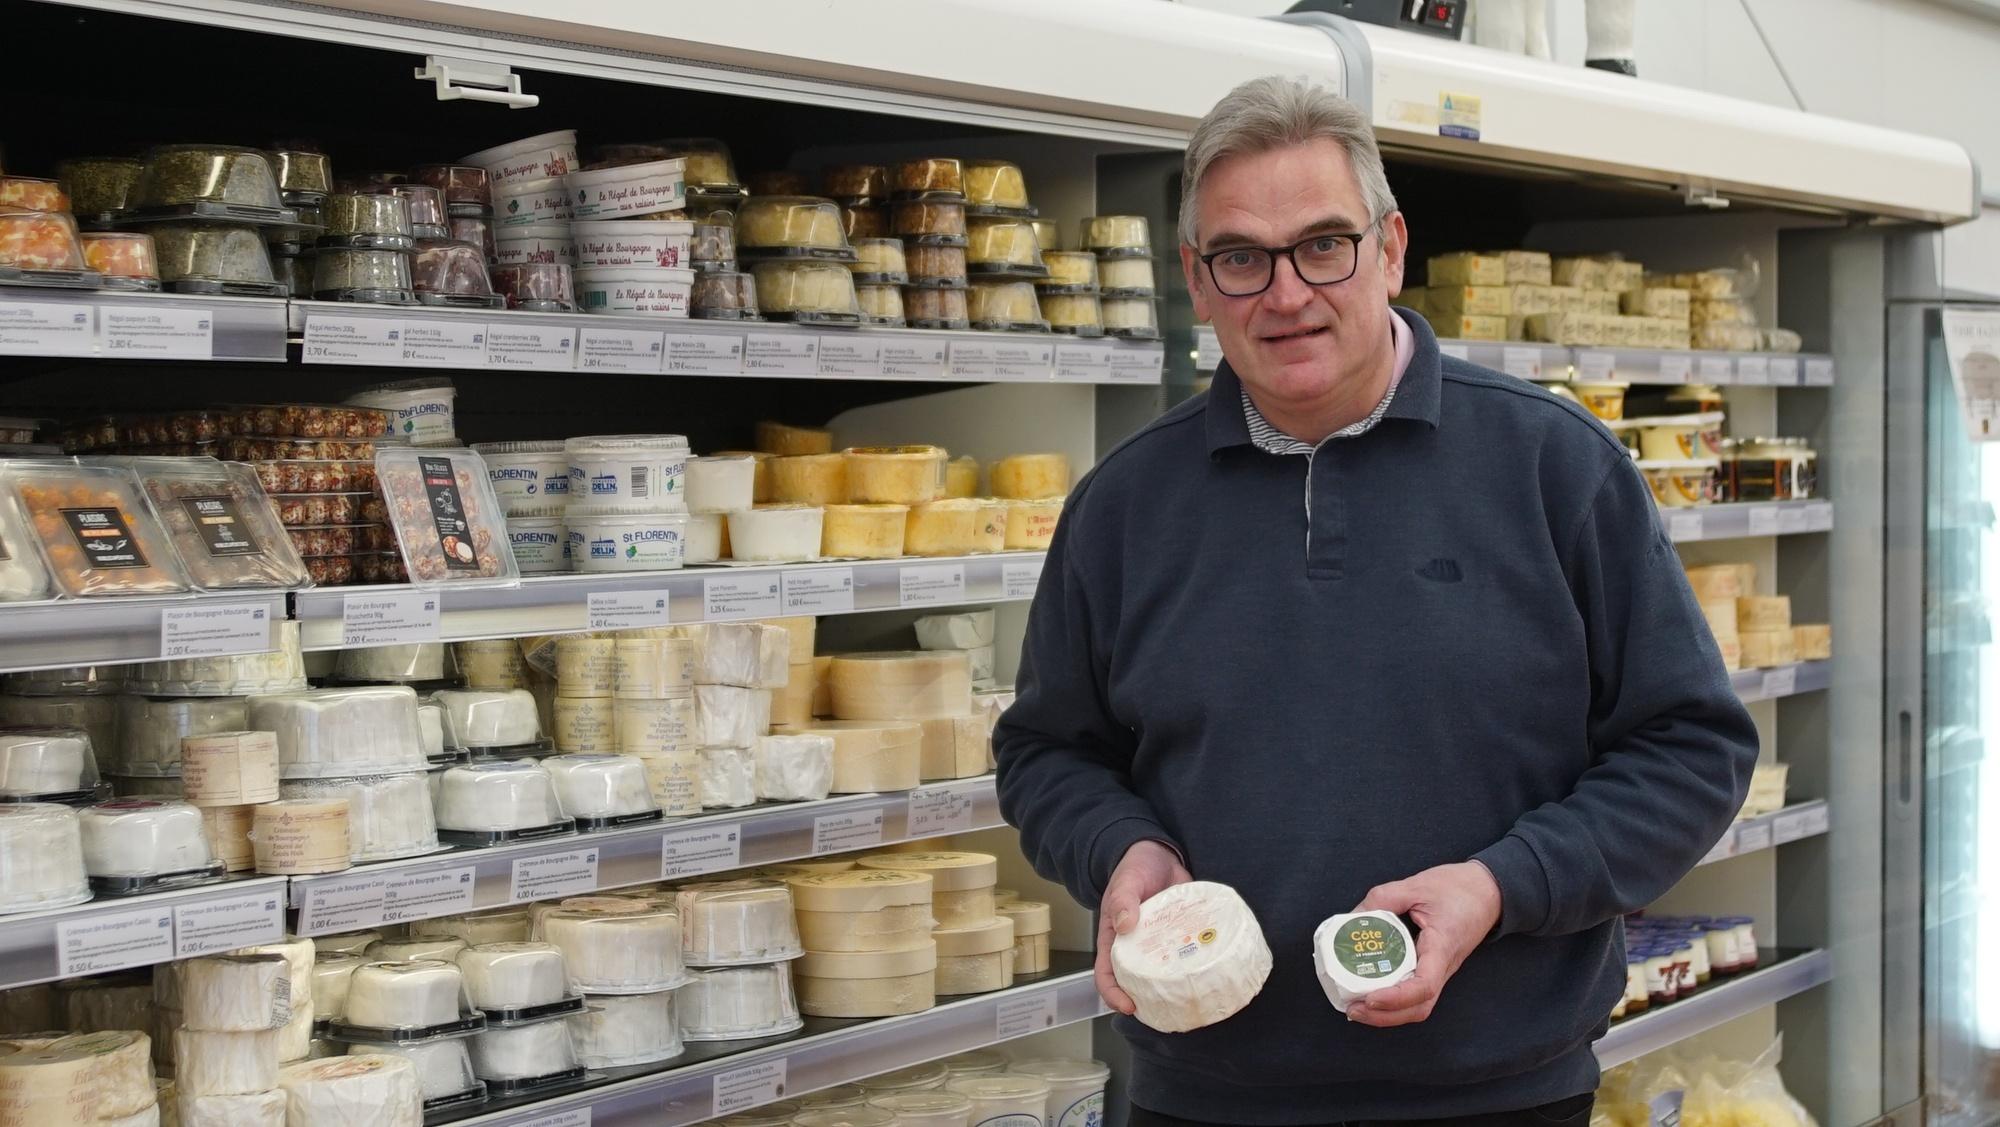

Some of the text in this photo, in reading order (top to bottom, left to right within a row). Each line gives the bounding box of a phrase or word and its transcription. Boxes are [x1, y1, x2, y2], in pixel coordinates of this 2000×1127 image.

[504, 162, 540, 178] Bourgogne
[599, 184, 672, 202] Le Régal de Bourgogne
[534, 197, 564, 212] Le Régal
[619, 198, 656, 212] aux raisins
[588, 243, 605, 255] Régal
[606, 243, 614, 252] de
[615, 242, 652, 255] Bourgogne
[609, 256, 632, 265] raisins
[615, 288, 625, 300] Le
[625, 288, 647, 302] Régal
[648, 288, 657, 299] de
[652, 302, 671, 312] raisins
[307, 347, 322, 357] 3,70
[410, 402, 449, 416] FLORENTIN
[665, 466, 673, 477] St
[592, 482, 617, 491] DELIN
[623, 530, 678, 543] St FLORENTIN
[591, 546, 617, 555] DELIN
[371, 601, 397, 610] Bourgogne
[185, 611, 193, 619] de
[193, 609, 223, 619] Bourgogne
[224, 608, 250, 617] Moutarde
[345, 635, 360, 645] 2,00
[167, 646, 184, 656] 2,00
[690, 834, 712, 843] Bourgogne
[545, 855, 569, 865] Bourgogne
[386, 874, 452, 890] Crémeux de Bourgogne Bleu
[313, 886, 336, 897] Crémeux
[337, 885, 344, 893] de
[344, 882, 371, 892] Bourgogne
[517, 889, 530, 899] 4,00
[180, 907, 205, 917] Crémeux
[206, 906, 213, 914] de
[213, 903, 242, 914] Bourgogne
[382, 911, 398, 921] 8,50
[94, 925, 102, 933] de
[103, 921, 132, 932] Bourgogne
[310, 919, 325, 929] 3,00
[1351, 929, 1382, 941] Côte
[180, 942, 198, 953] 4,00
[1354, 940, 1384, 953] d'Or
